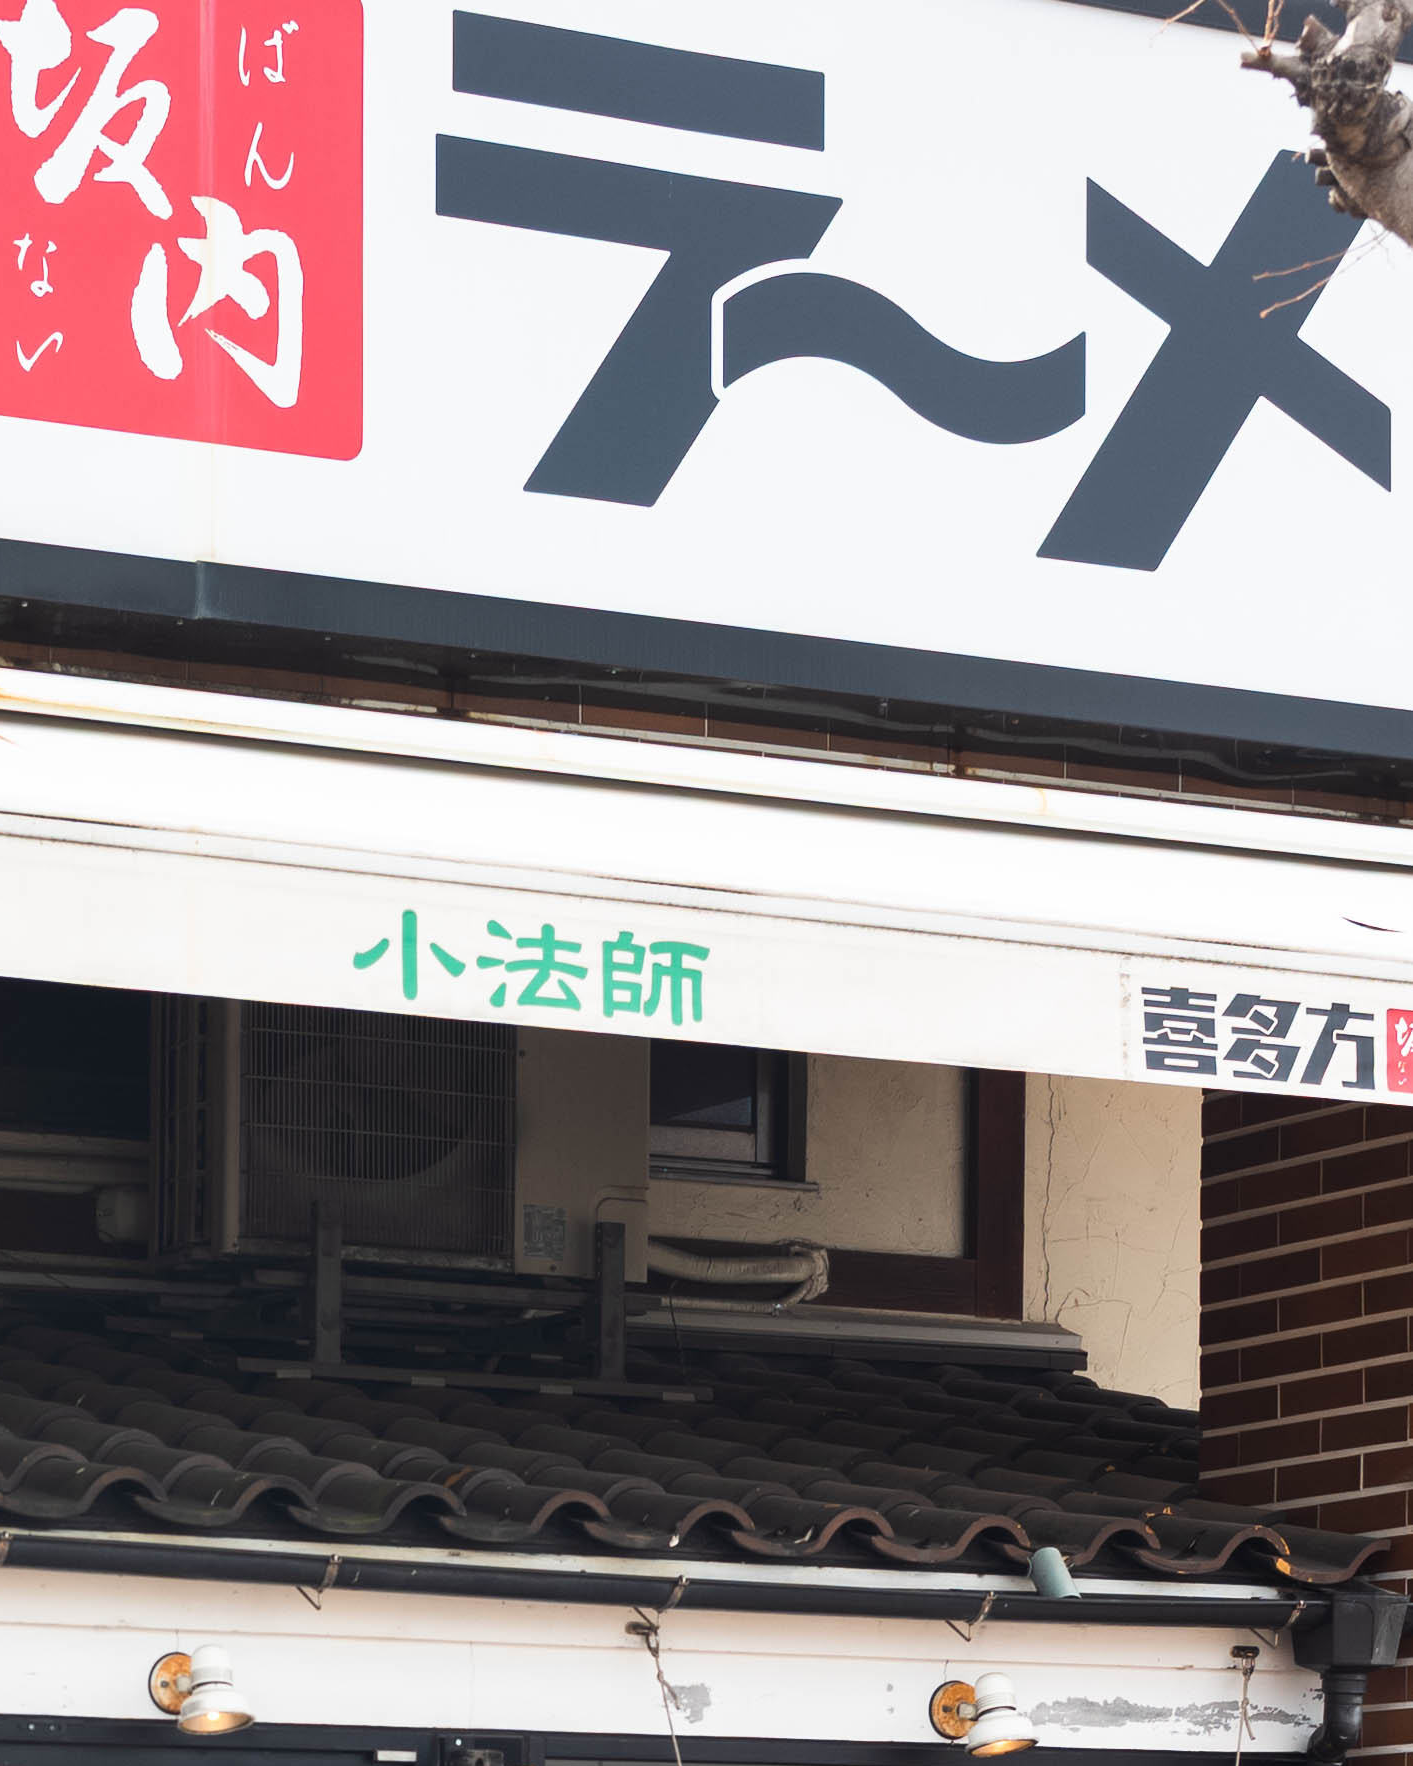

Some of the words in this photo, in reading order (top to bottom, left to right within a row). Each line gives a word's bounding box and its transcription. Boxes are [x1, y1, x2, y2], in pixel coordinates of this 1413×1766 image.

[353, 909, 710, 1027] 小法師
[1141, 986, 1375, 1090] 喜多方
